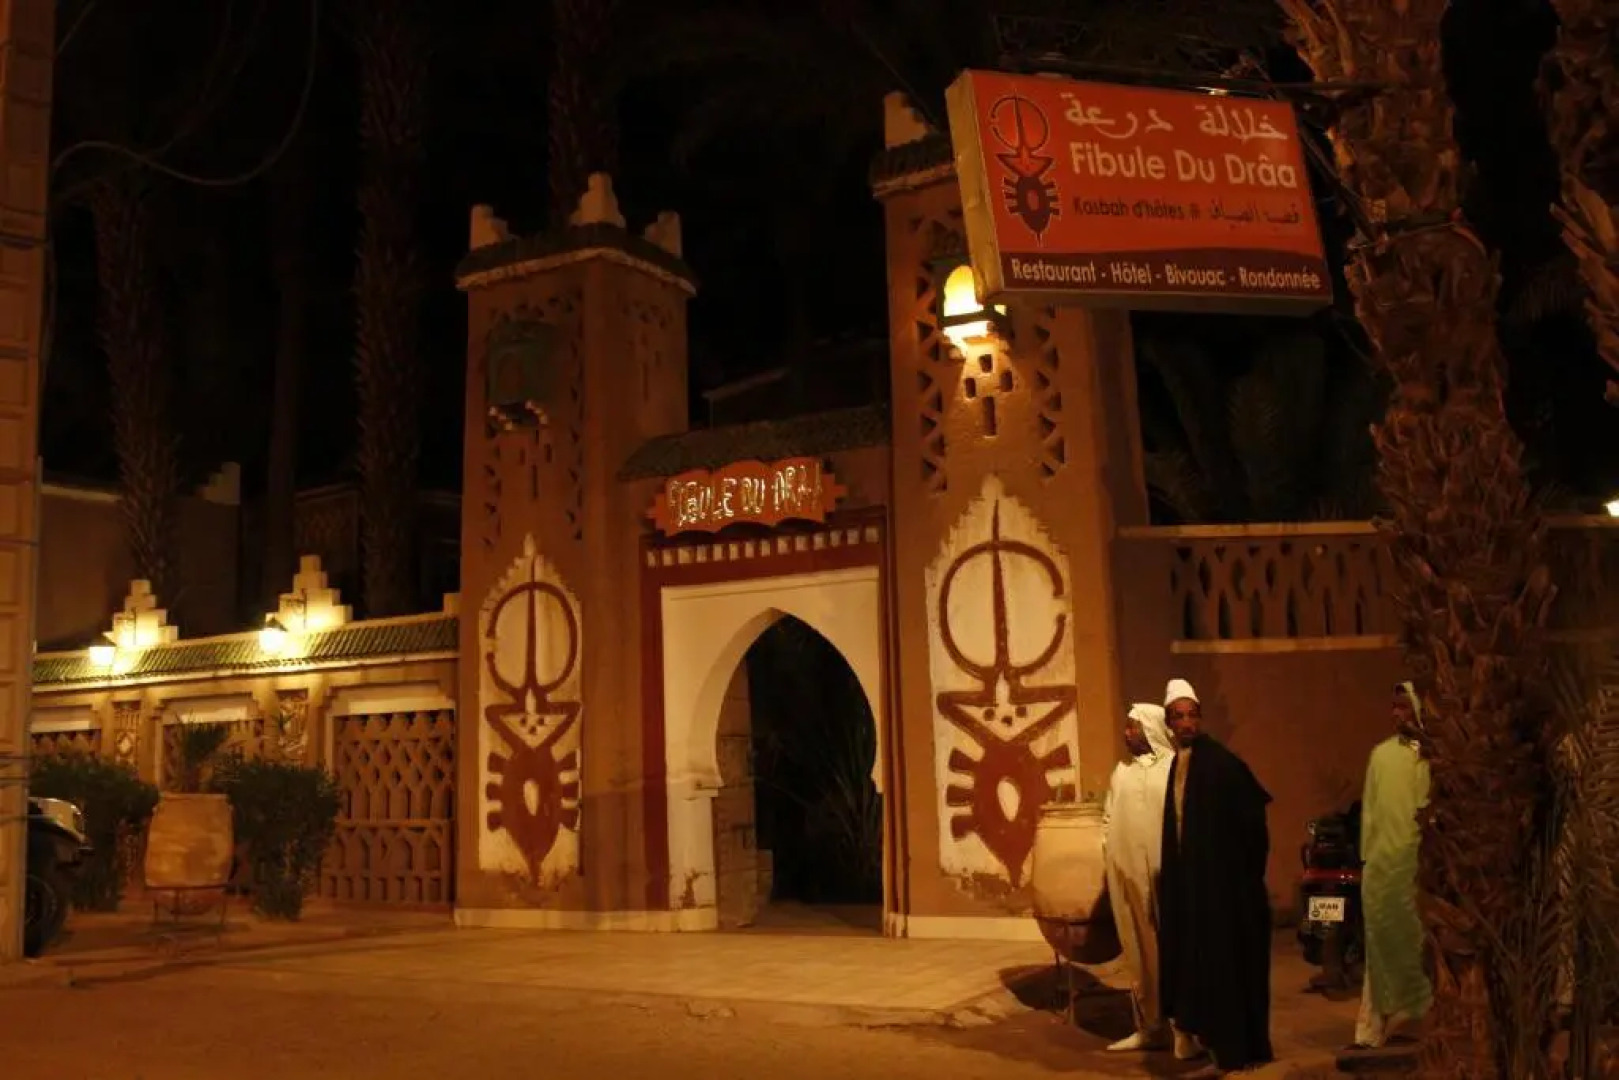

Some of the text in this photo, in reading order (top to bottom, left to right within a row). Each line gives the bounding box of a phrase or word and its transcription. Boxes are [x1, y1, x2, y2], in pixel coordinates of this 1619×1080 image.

[1069, 141, 1298, 189] Fibule Du Drâa
[1072, 195, 1129, 217] Kasbah
[1011, 257, 1097, 282] Restaurant
[1111, 261, 1152, 284] Hôtel
[1166, 264, 1225, 287] Bivouac
